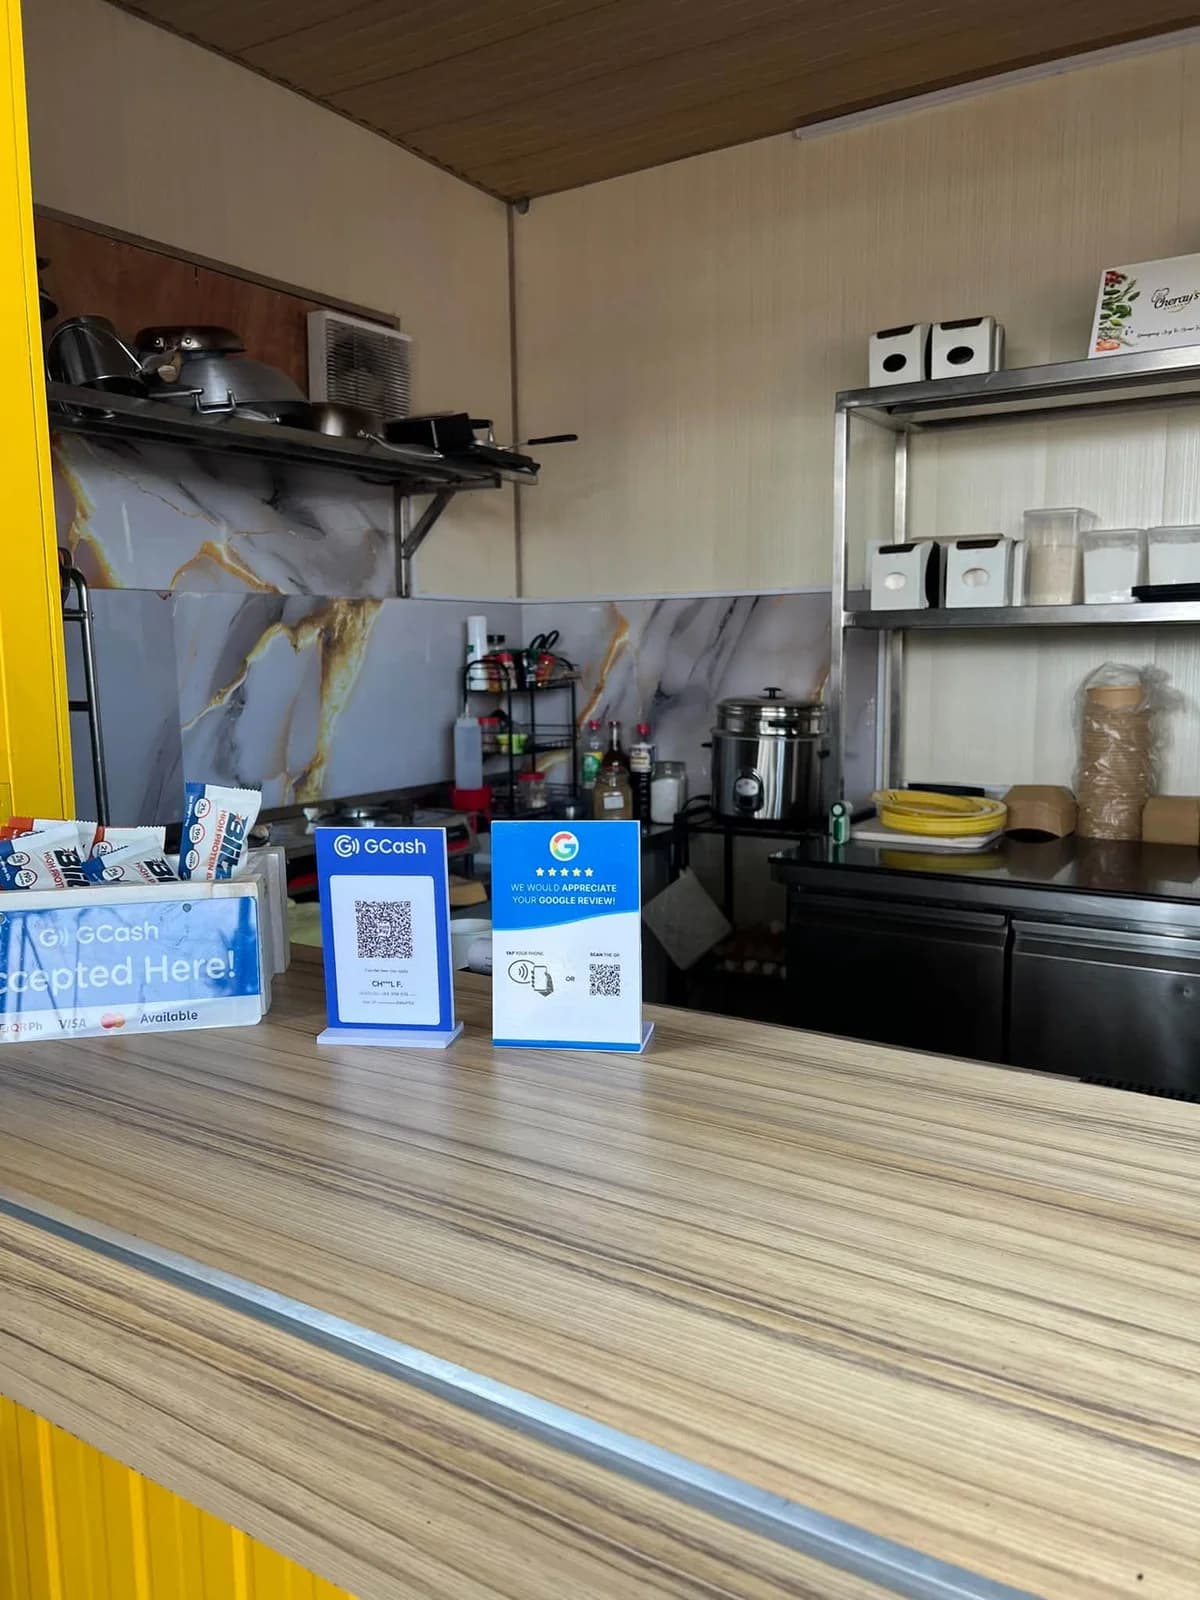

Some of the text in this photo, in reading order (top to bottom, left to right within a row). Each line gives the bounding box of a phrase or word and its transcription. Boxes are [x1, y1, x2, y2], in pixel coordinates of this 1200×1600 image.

[207, 833, 222, 871] PROTEIN
[364, 838, 426, 854] GCash
[511, 883, 617, 893] WE WOULD APPRECIATE
[512, 896, 616, 905] YOUR GOOGLE REVIEW!
[76, 921, 159, 945] GCash
[144, 949, 236, 984] Here!
[58, 1018, 87, 1030] VISA
[140, 1010, 199, 1024] Available
